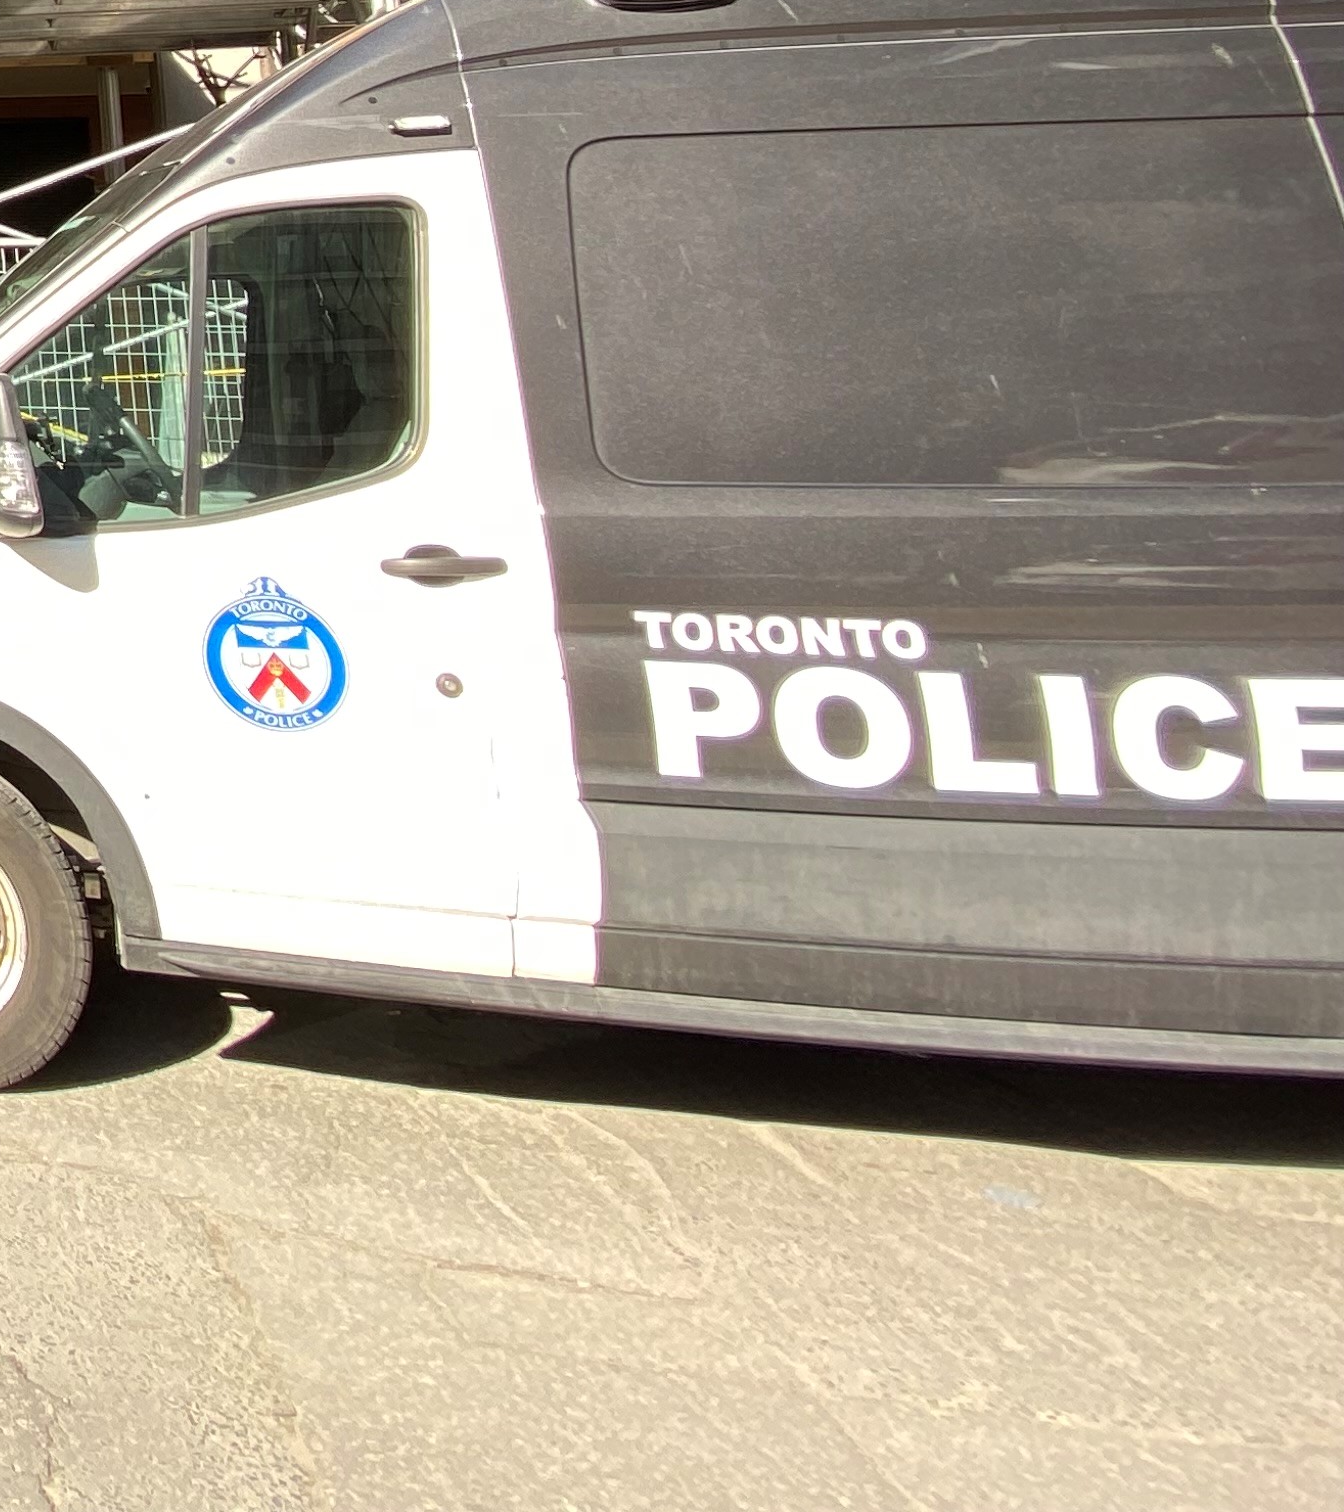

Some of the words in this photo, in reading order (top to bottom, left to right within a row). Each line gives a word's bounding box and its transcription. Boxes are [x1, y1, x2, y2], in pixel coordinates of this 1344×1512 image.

[228, 599, 309, 621] TORONTO
[632, 610, 929, 661] TORONTO
[253, 709, 313, 729] POLICE
[642, 659, 1344, 803] POLICE
